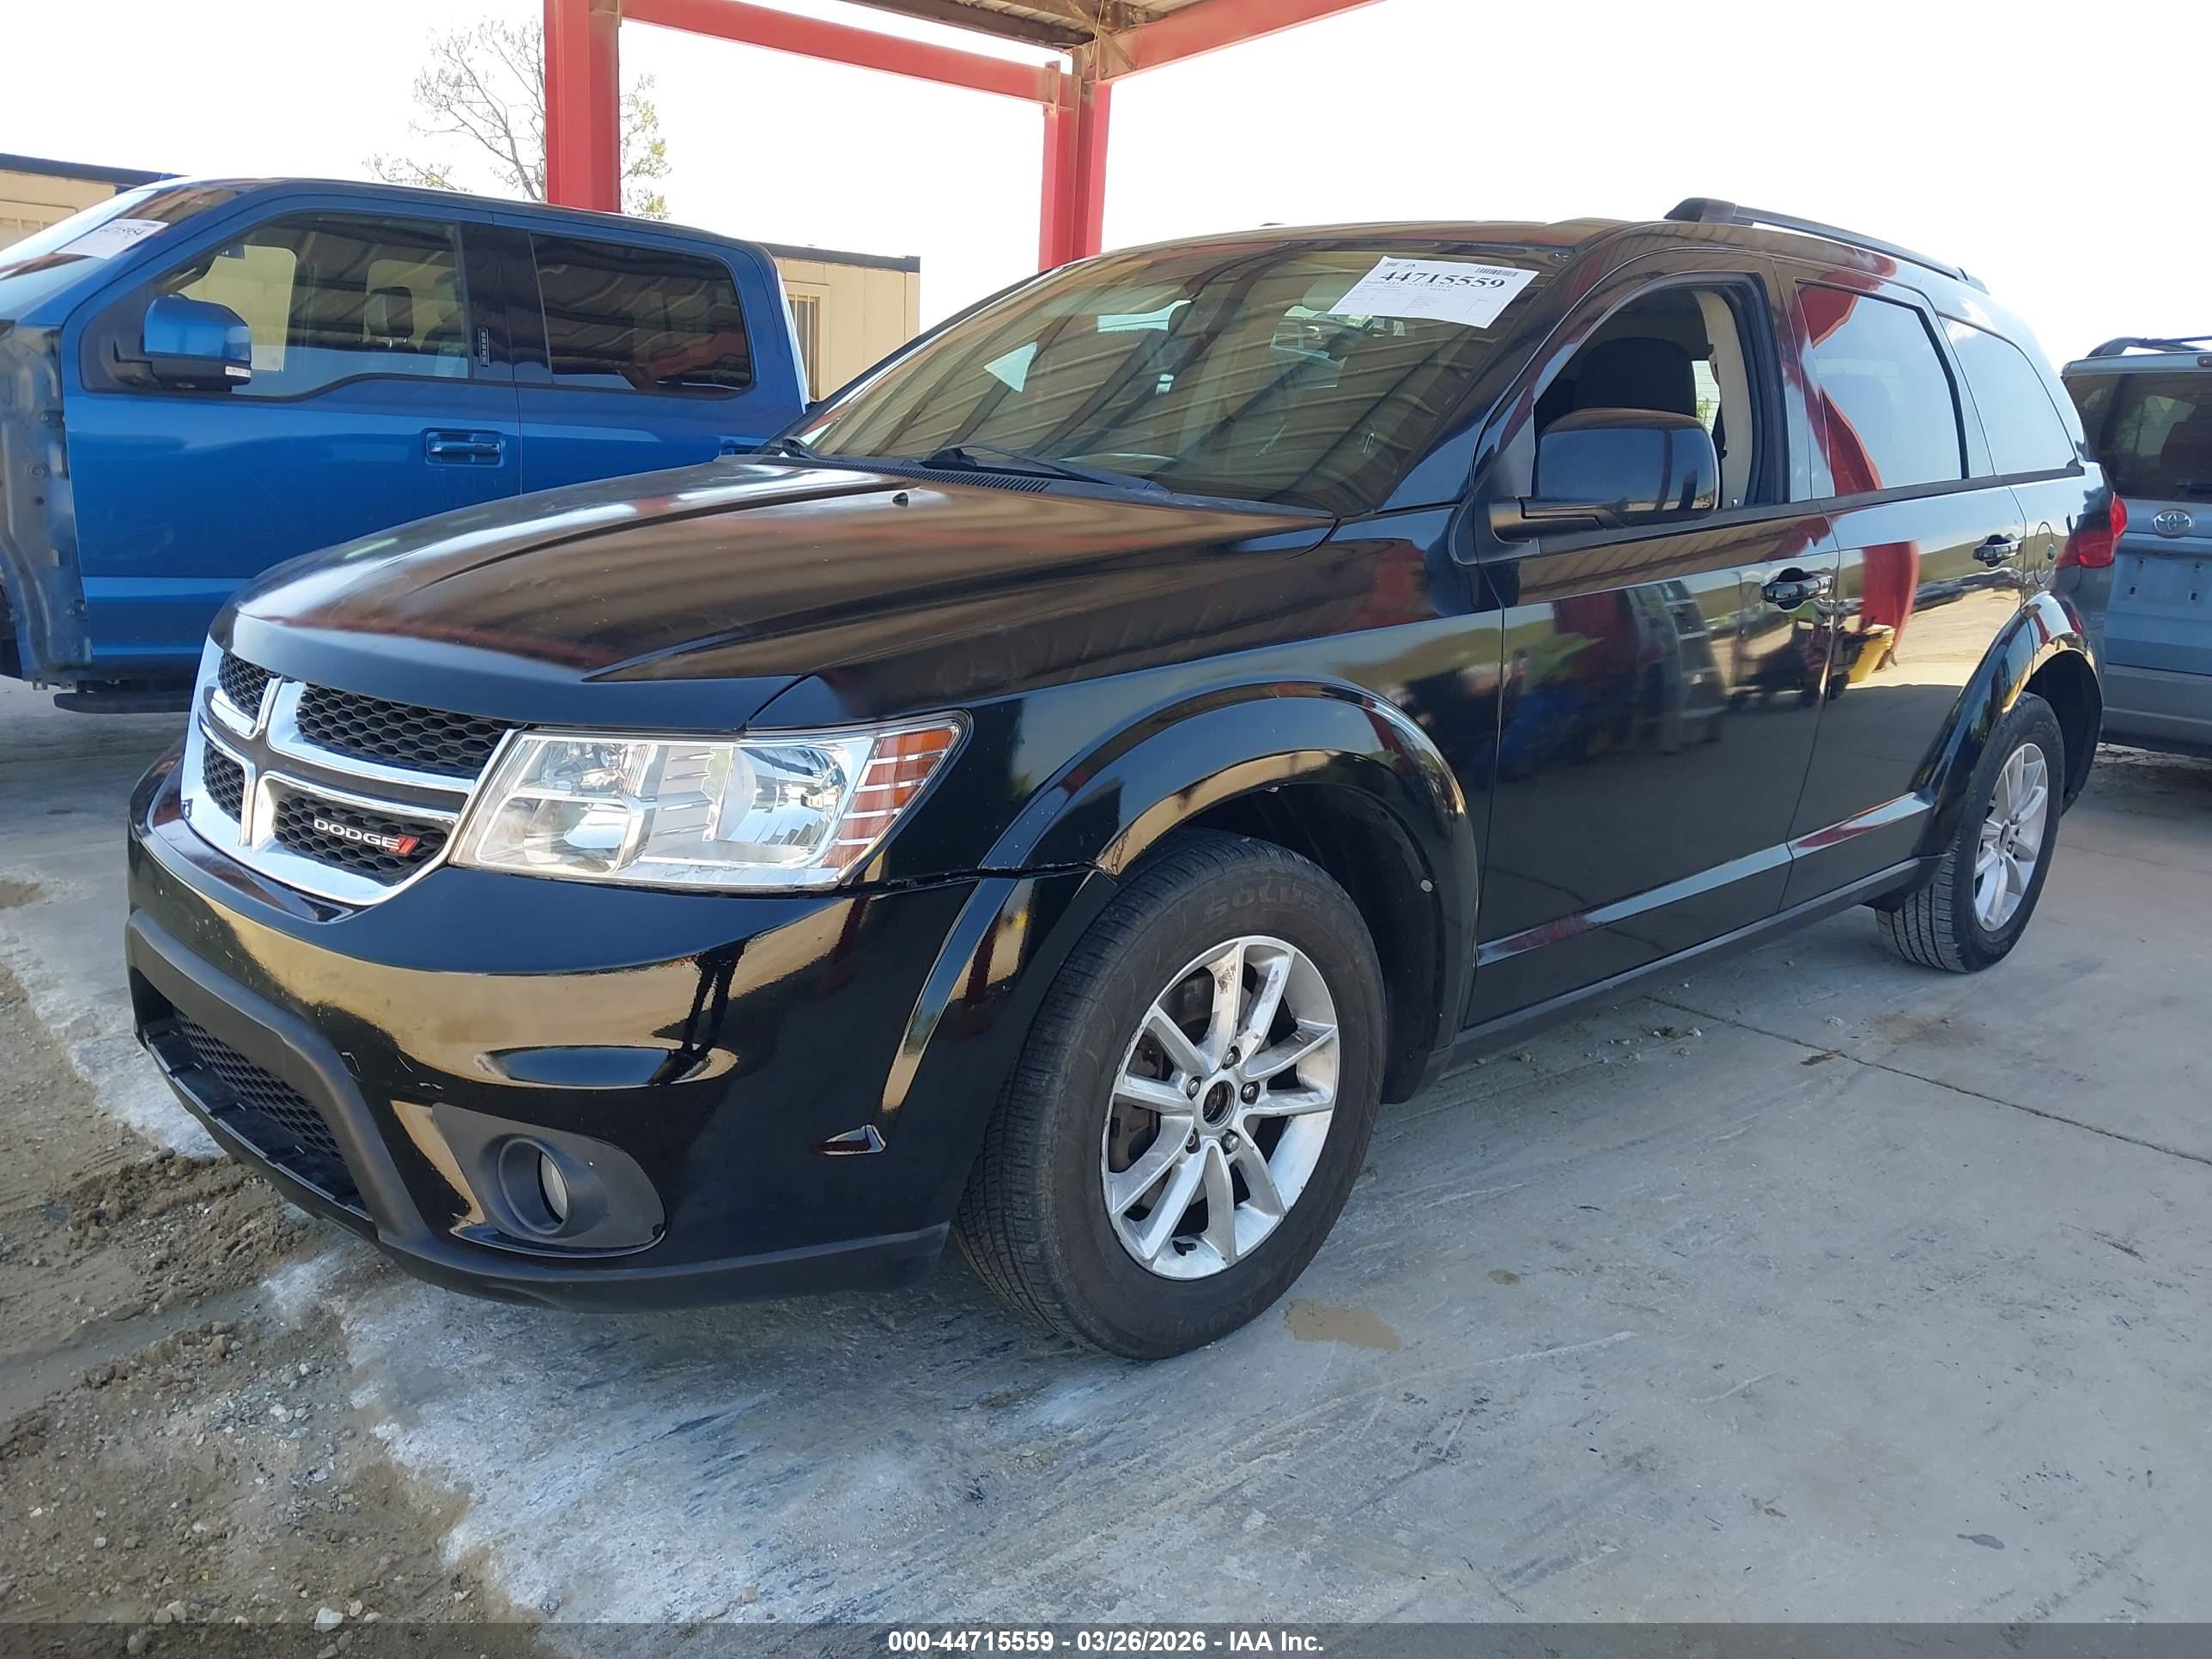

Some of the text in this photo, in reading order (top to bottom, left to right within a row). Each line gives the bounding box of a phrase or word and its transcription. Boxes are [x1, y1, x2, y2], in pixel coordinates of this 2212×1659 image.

[1380, 271, 1505, 289] 44715559
[313, 819, 399, 849] DODGE
[1204, 881, 1321, 921] SOLUS
